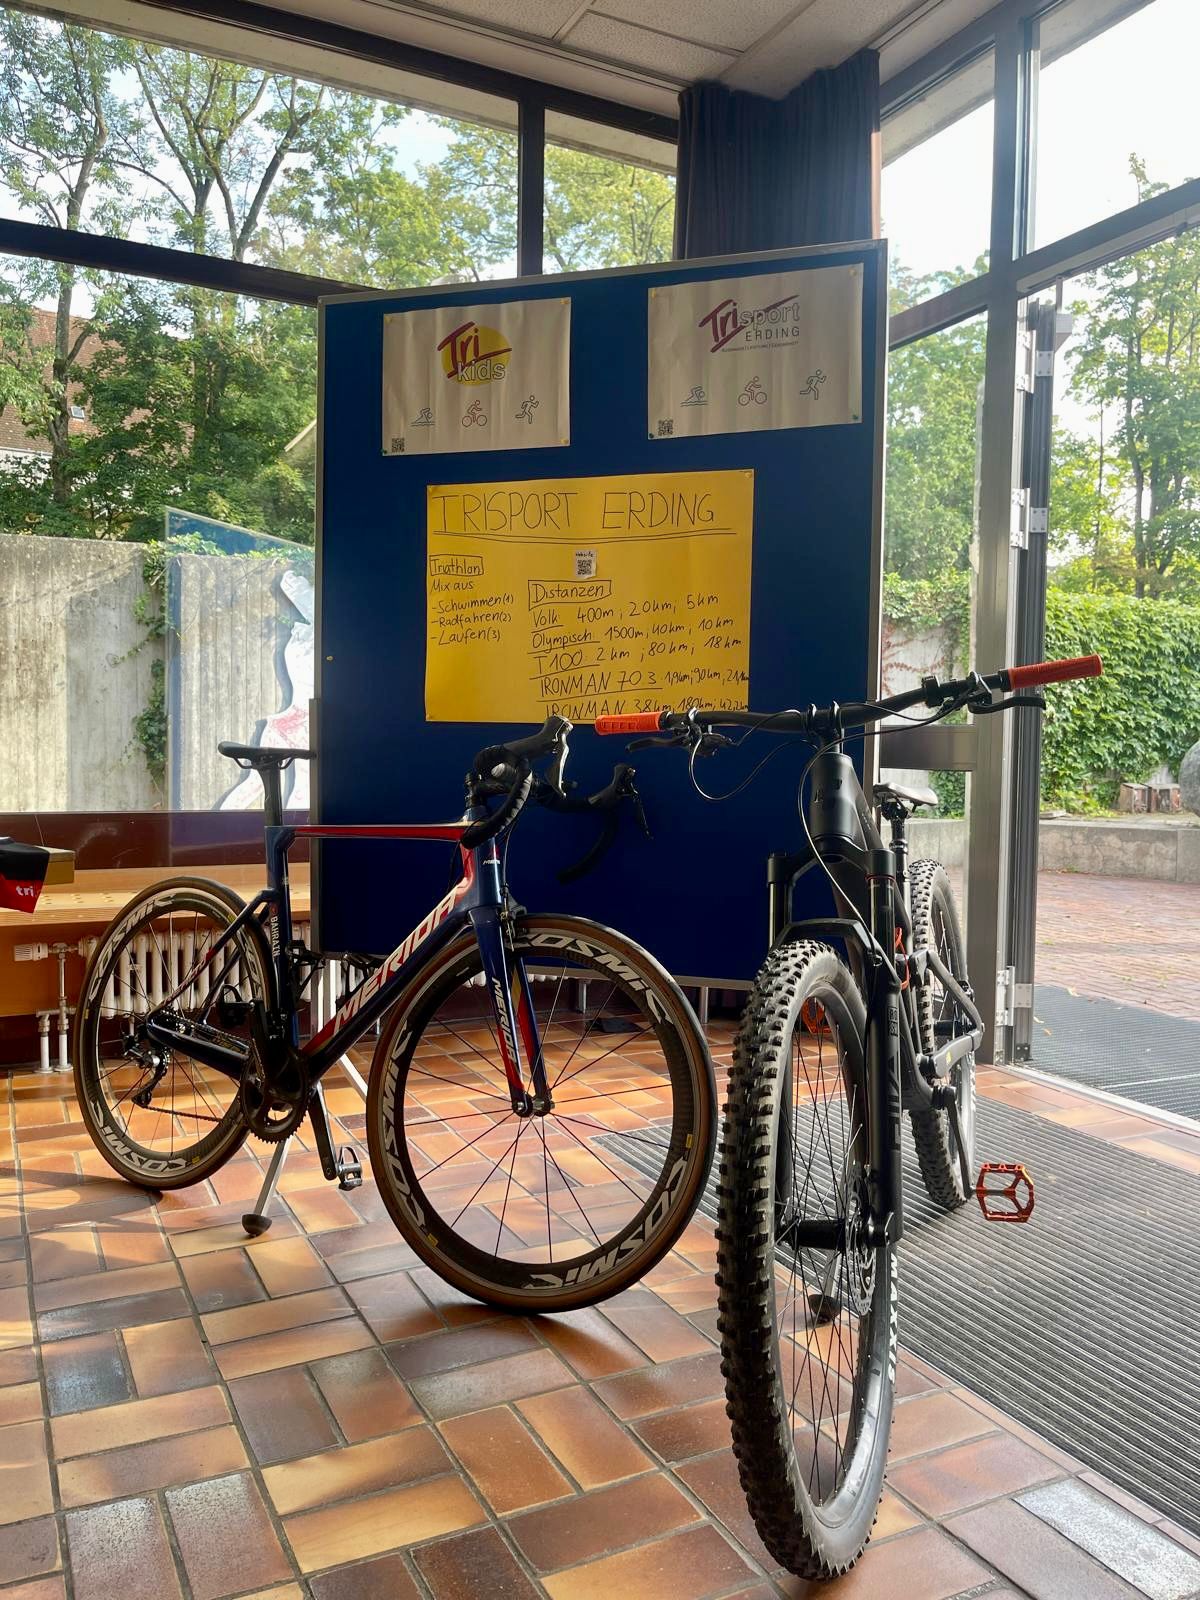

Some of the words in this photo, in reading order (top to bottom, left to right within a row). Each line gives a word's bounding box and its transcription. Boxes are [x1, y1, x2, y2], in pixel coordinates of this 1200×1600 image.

[745, 326, 800, 342] ERDING
[457, 359, 506, 381] kids
[432, 491, 578, 532] TRISPORT
[602, 491, 714, 529] ERDING
[430, 558, 481, 576] Triathlon
[430, 579, 450, 593] Mix
[453, 581, 474, 591] aus
[532, 583, 604, 603] Distanzen
[533, 609, 559, 628] Volk
[532, 629, 592, 653] Olympisch
[541, 671, 611, 697] IRONMAN
[334, 893, 457, 1037] MERIDA
[492, 977, 520, 1072] MERIDA
